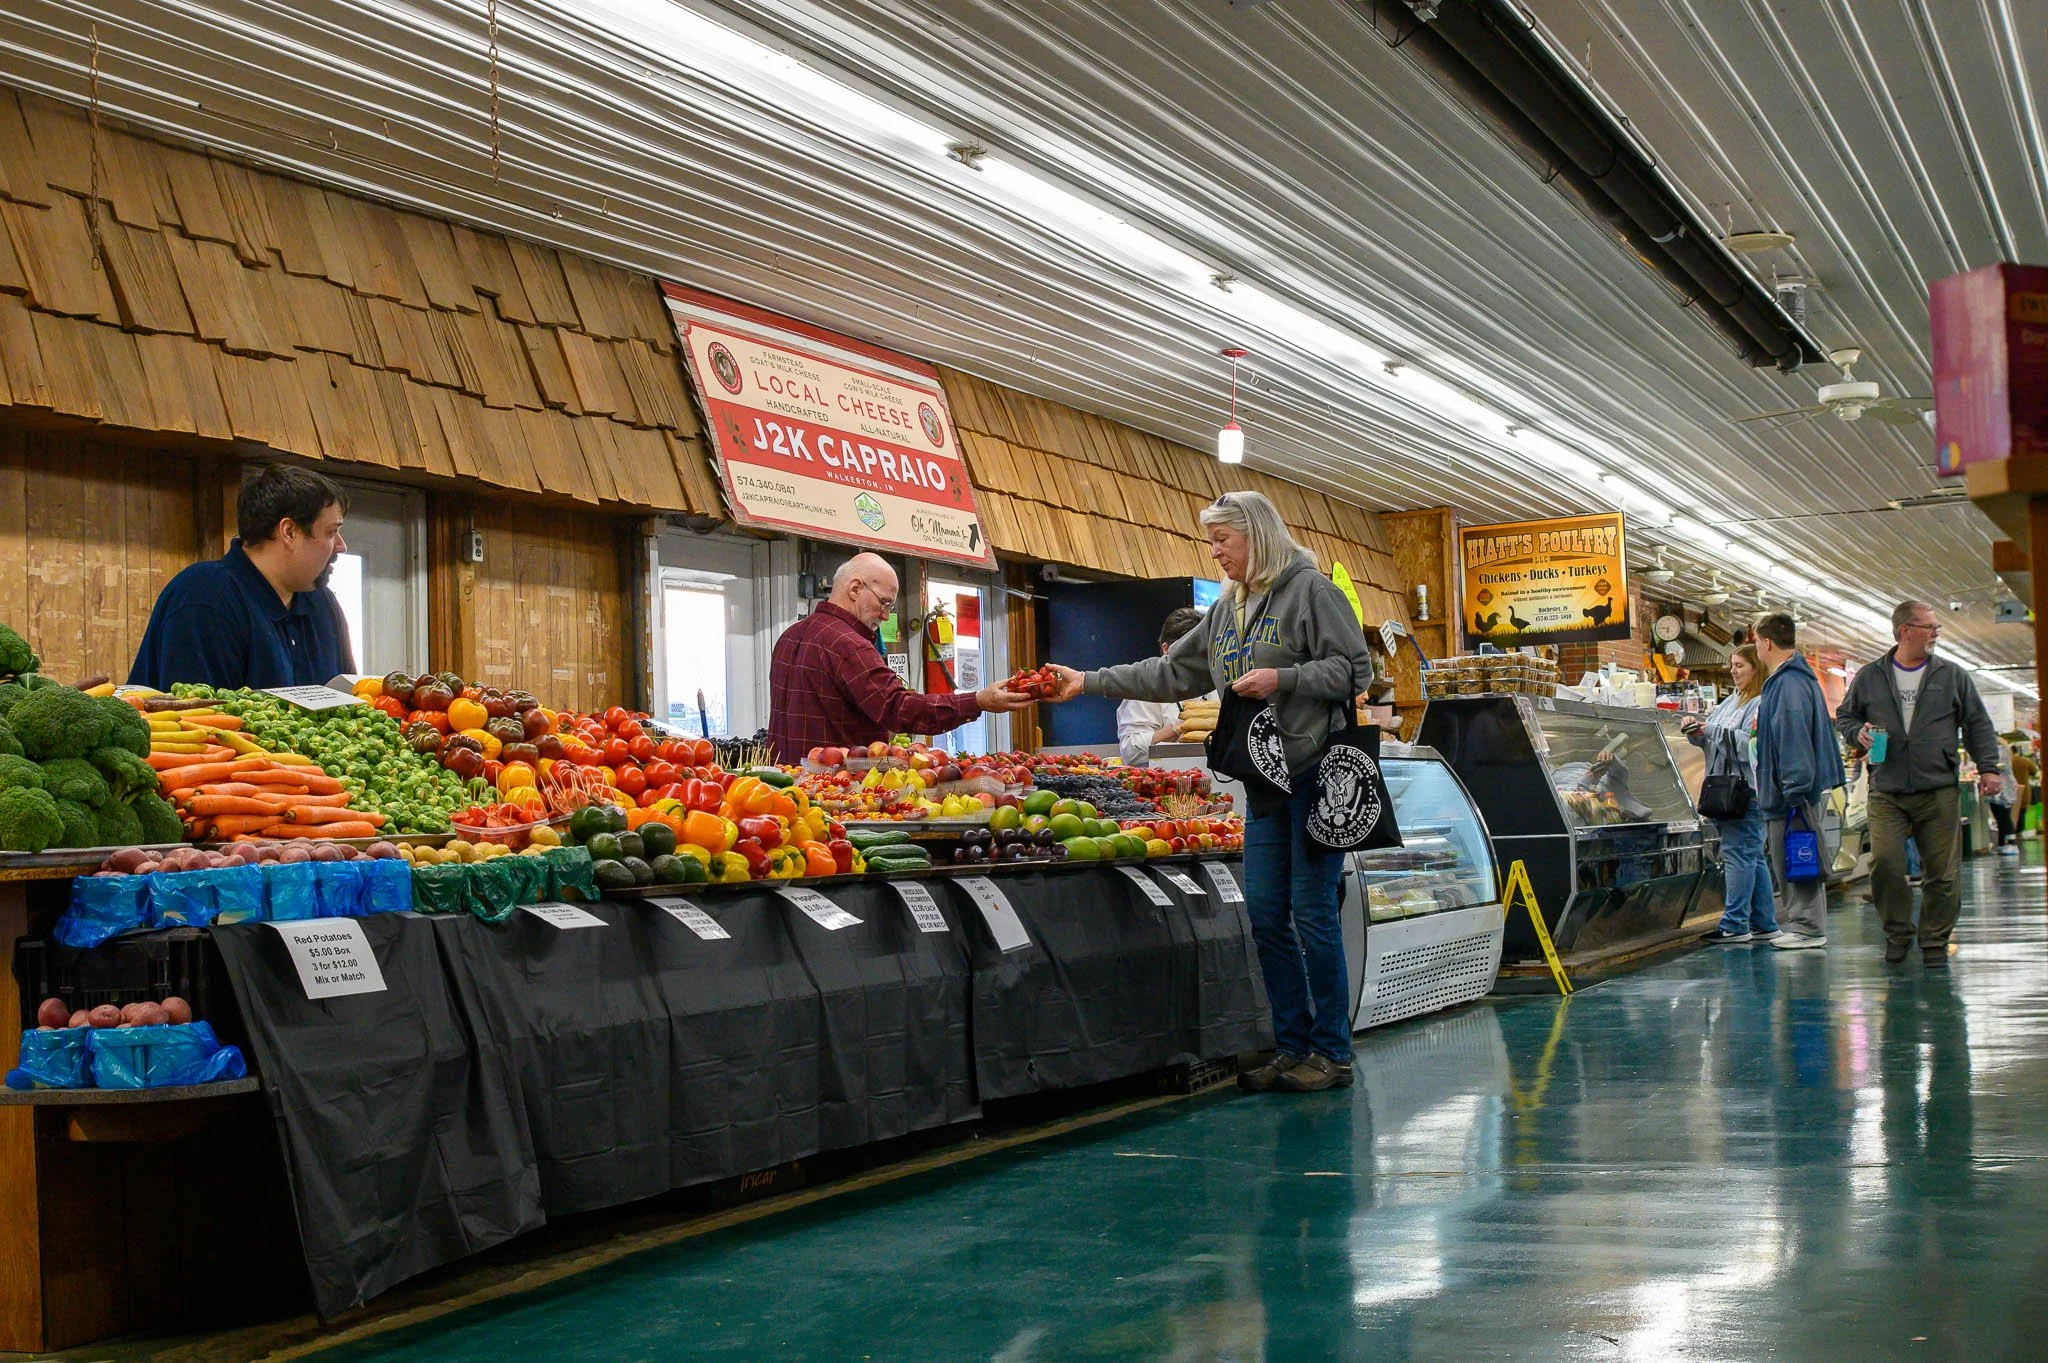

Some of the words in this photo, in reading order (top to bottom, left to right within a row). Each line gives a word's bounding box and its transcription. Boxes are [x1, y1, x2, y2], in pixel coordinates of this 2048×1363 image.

[763, 352, 804, 368] FARMSTEAD
[776, 363, 793, 373] MILK
[794, 368, 821, 381] CHEESE
[851, 378, 891, 394] SMALL-SCALE
[754, 370, 829, 407] LOCAL
[837, 394, 912, 429] CHEESE
[880, 394, 904, 405] CHEESE
[766, 399, 829, 422] HANDCRAFTED
[860, 424, 911, 443] ALL-NATURAL
[753, 417, 814, 462] J2K
[817, 434, 946, 491] CAPRAIO
[737, 476, 795, 495] 574.340.0847
[826, 471, 882, 490] WALKERTON,
[885, 484, 895, 492] IN
[1466, 533, 1533, 569] HIATT'S
[1538, 526, 1617, 557] POULTRY
[1479, 571, 1521, 585] Chickens
[1530, 568, 1559, 580] Ducks
[1568, 563, 1607, 577] Turkeys
[889, 655, 906, 664] PROUD
[1250, 735, 1266, 770] NORMAL
[1265, 768, 1273, 777] IL
[1346, 748, 1376, 775] RECORDS
[1351, 764, 1364, 780] TRADE
[1330, 837, 1338, 845] IL
[1338, 803, 1379, 845] 309-452-4533
[1347, 820, 1357, 830] AND
[1356, 804, 1367, 821] MORE
[803, 903, 823, 912] $2.00
[912, 904, 924, 912] $2.00
[293, 935, 313, 945] Red
[313, 932, 352, 943] Potatoes
[309, 947, 333, 958] $5.00
[334, 946, 351, 955] Box
[312, 963, 319, 971] 3
[319, 961, 331, 970] for
[332, 958, 358, 969] $12.00
[314, 976, 330, 985] Mix
[331, 975, 340, 983] or
[341, 971, 366, 982] Match
